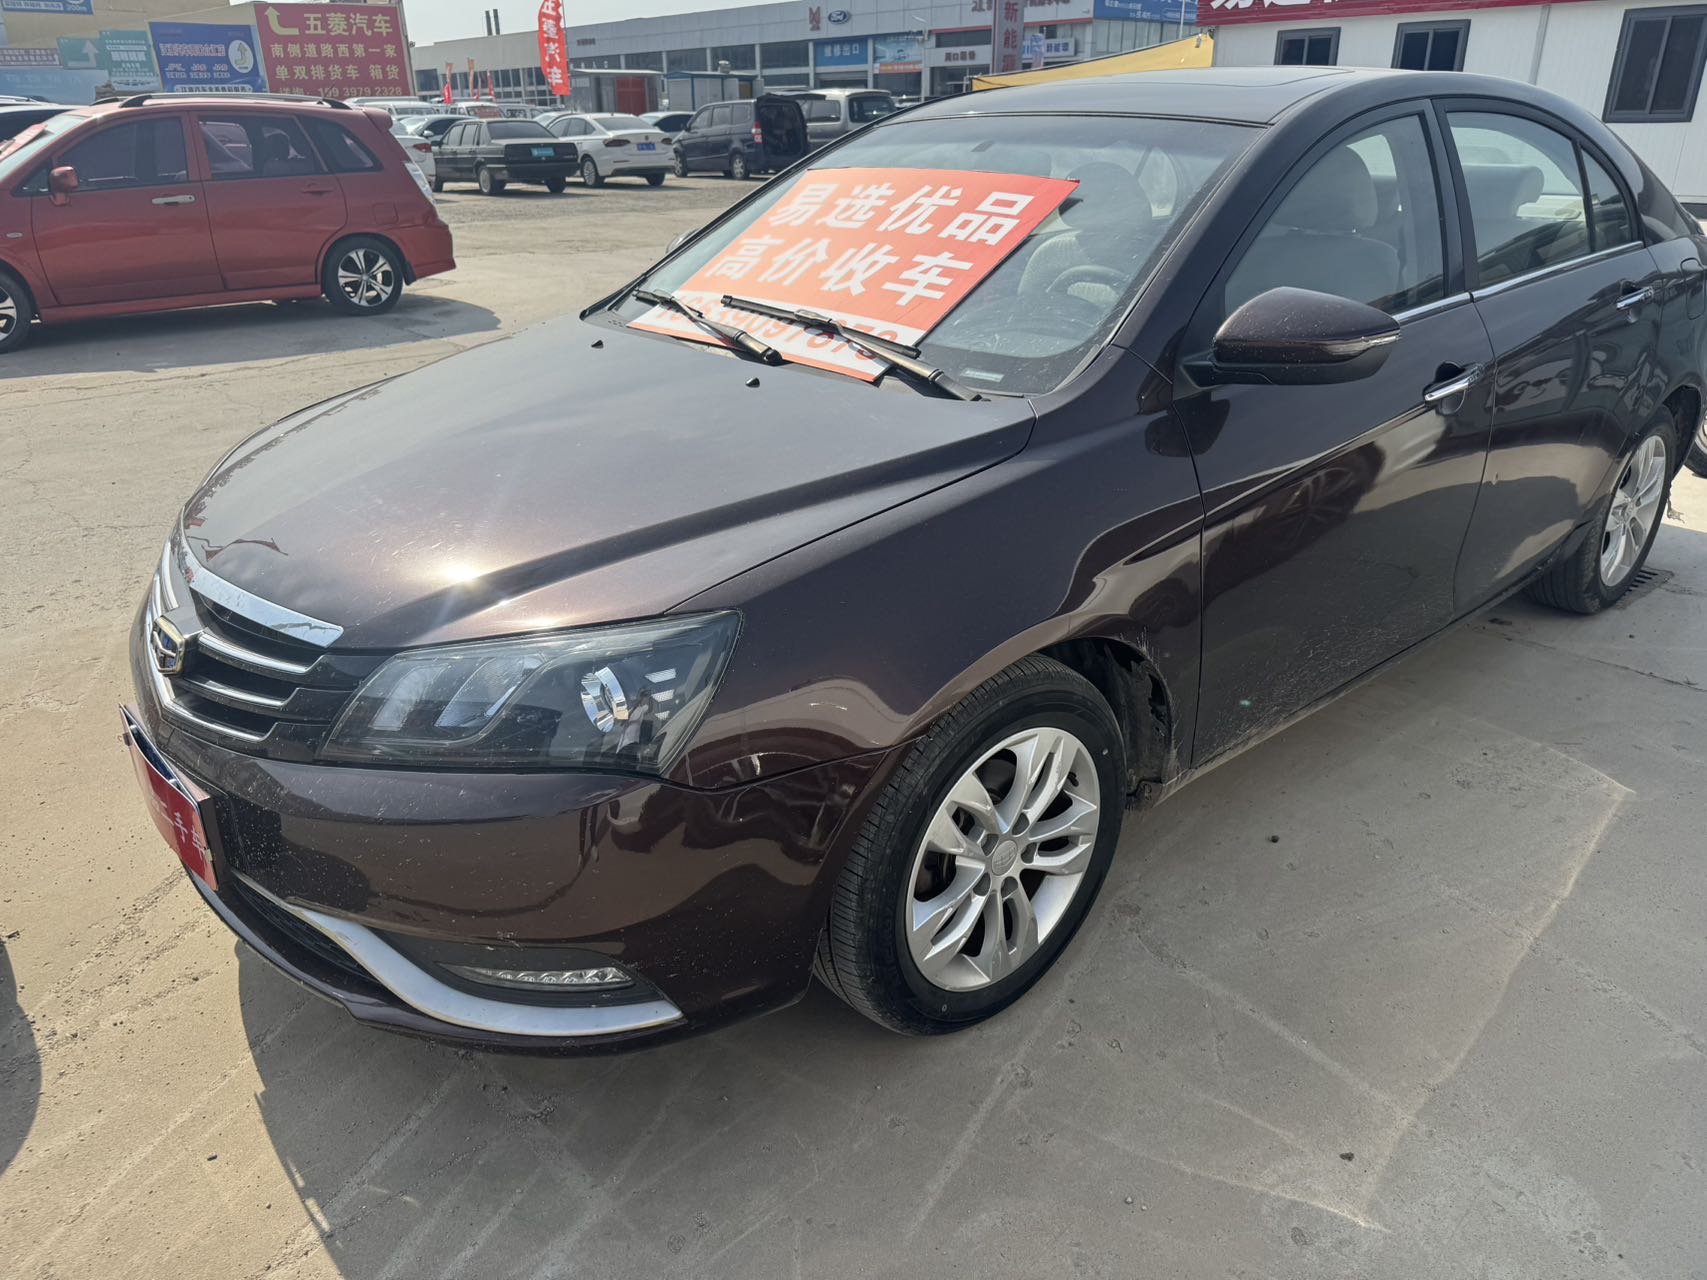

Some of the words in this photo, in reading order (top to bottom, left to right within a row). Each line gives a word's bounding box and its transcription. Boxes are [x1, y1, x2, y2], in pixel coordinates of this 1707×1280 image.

[303, 13, 393, 37] 五菱汽车
[270, 43, 397, 58] 南侧道路西第一家
[275, 64, 360, 80] 单双排货车
[369, 64, 399, 80] 箱货
[769, 182, 1034, 246] 易选优品
[704, 234, 974, 306] 高价收车
